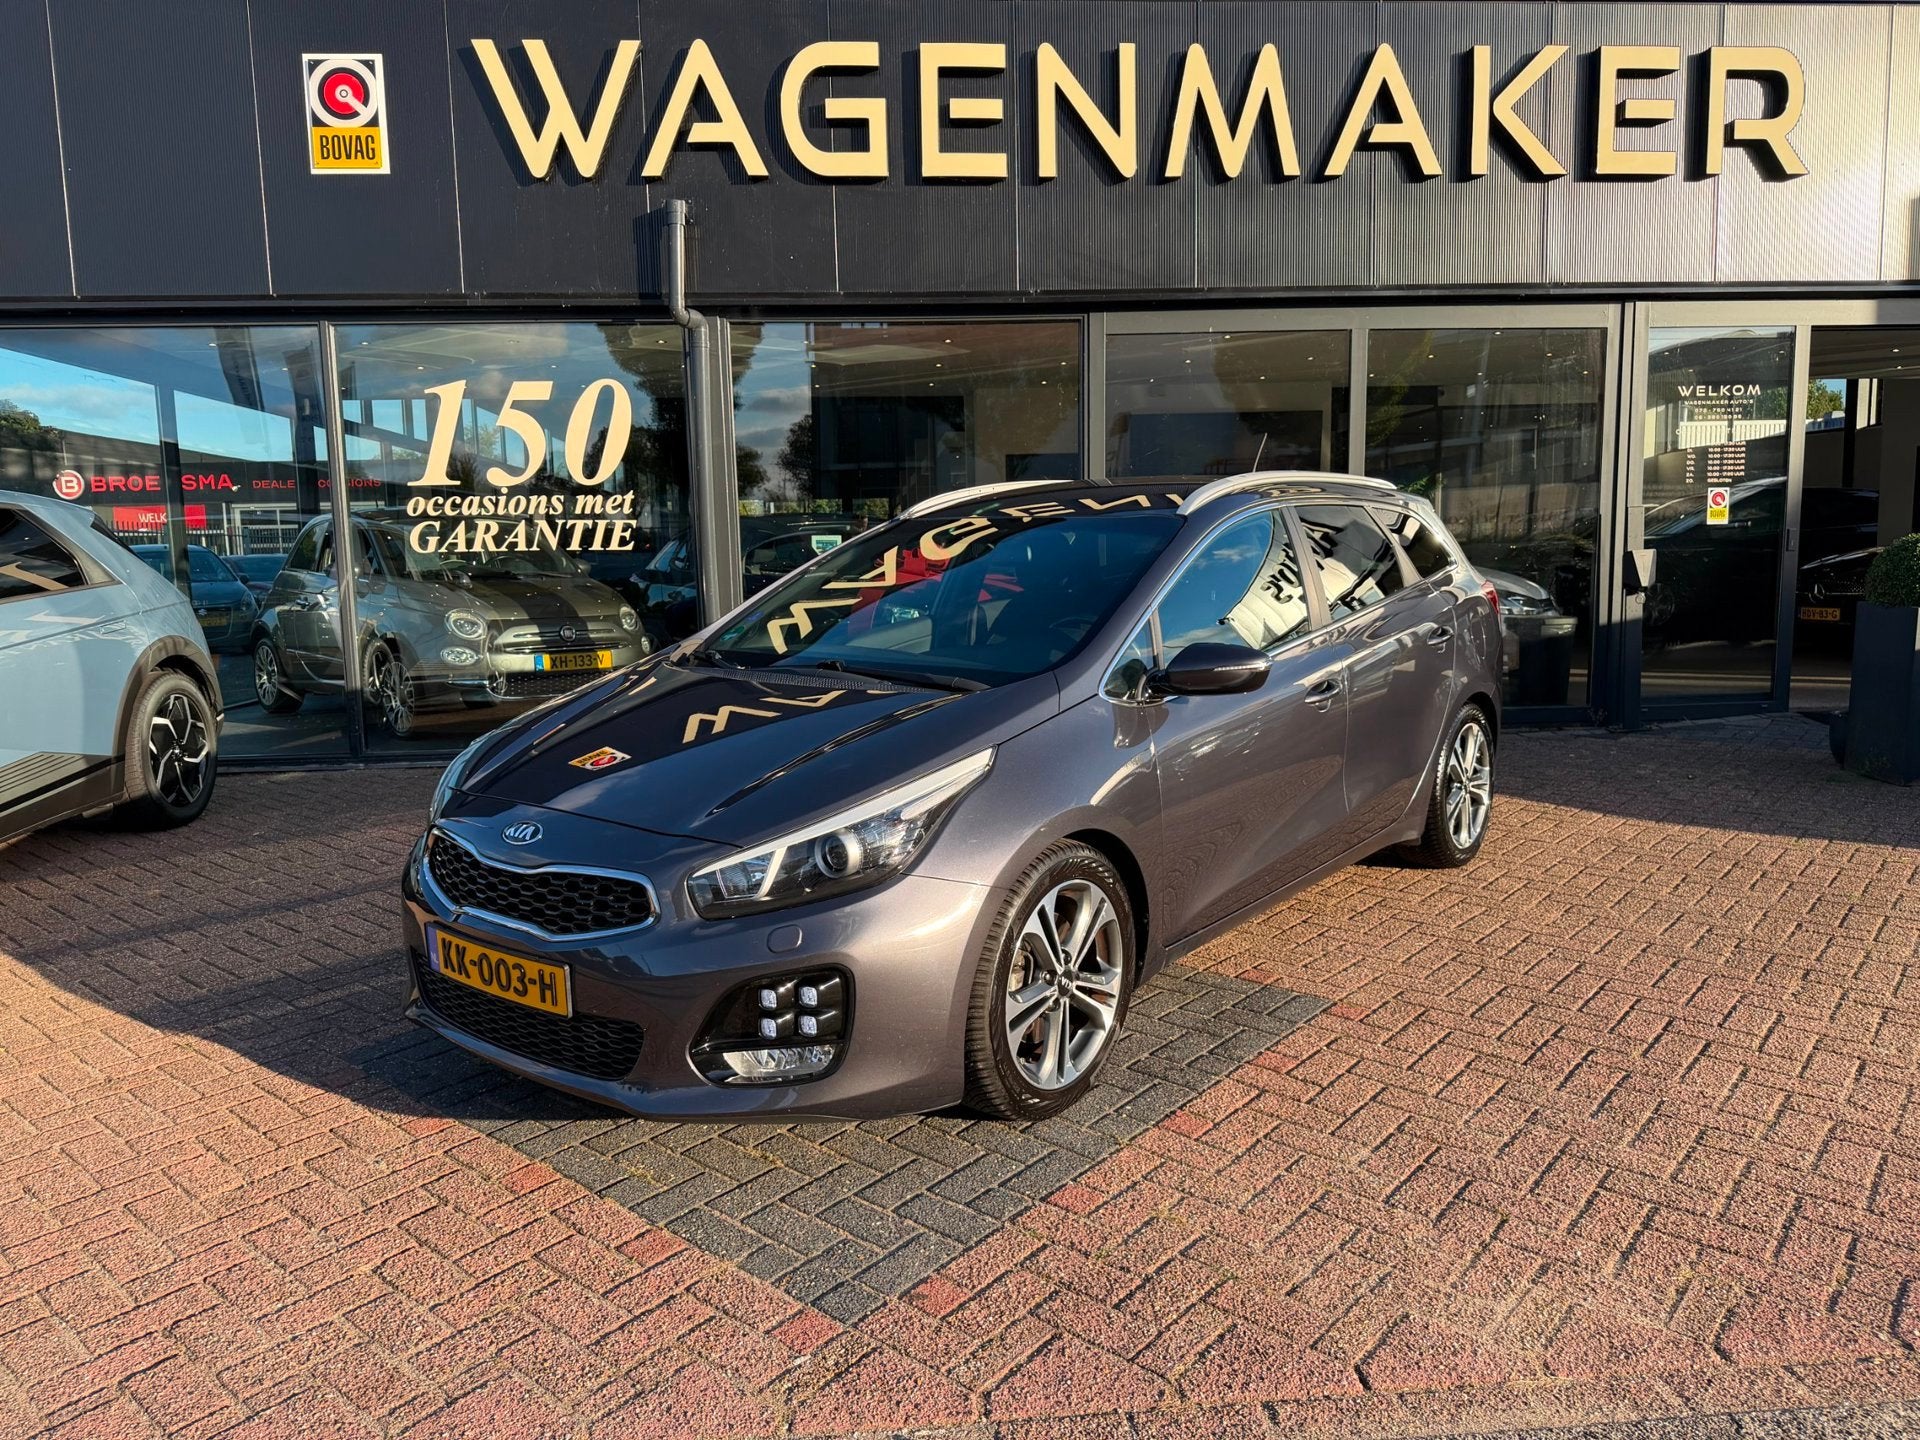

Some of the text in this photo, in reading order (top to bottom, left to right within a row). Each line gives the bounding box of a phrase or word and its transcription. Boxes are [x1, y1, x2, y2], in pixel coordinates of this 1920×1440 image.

[470, 39, 1809, 179] WAGENMAKER
[319, 133, 376, 161] BOVAG
[1677, 384, 1761, 397] WELKOM
[406, 377, 633, 487] 150
[91, 474, 234, 493] BROESMA
[252, 479, 296, 489] DEALE
[406, 487, 635, 517] occasions met
[409, 519, 638, 554] GARANTIE
[550, 653, 605, 670] XH-133-V
[505, 823, 536, 841] KIA
[441, 937, 559, 1007] KK-003-H
